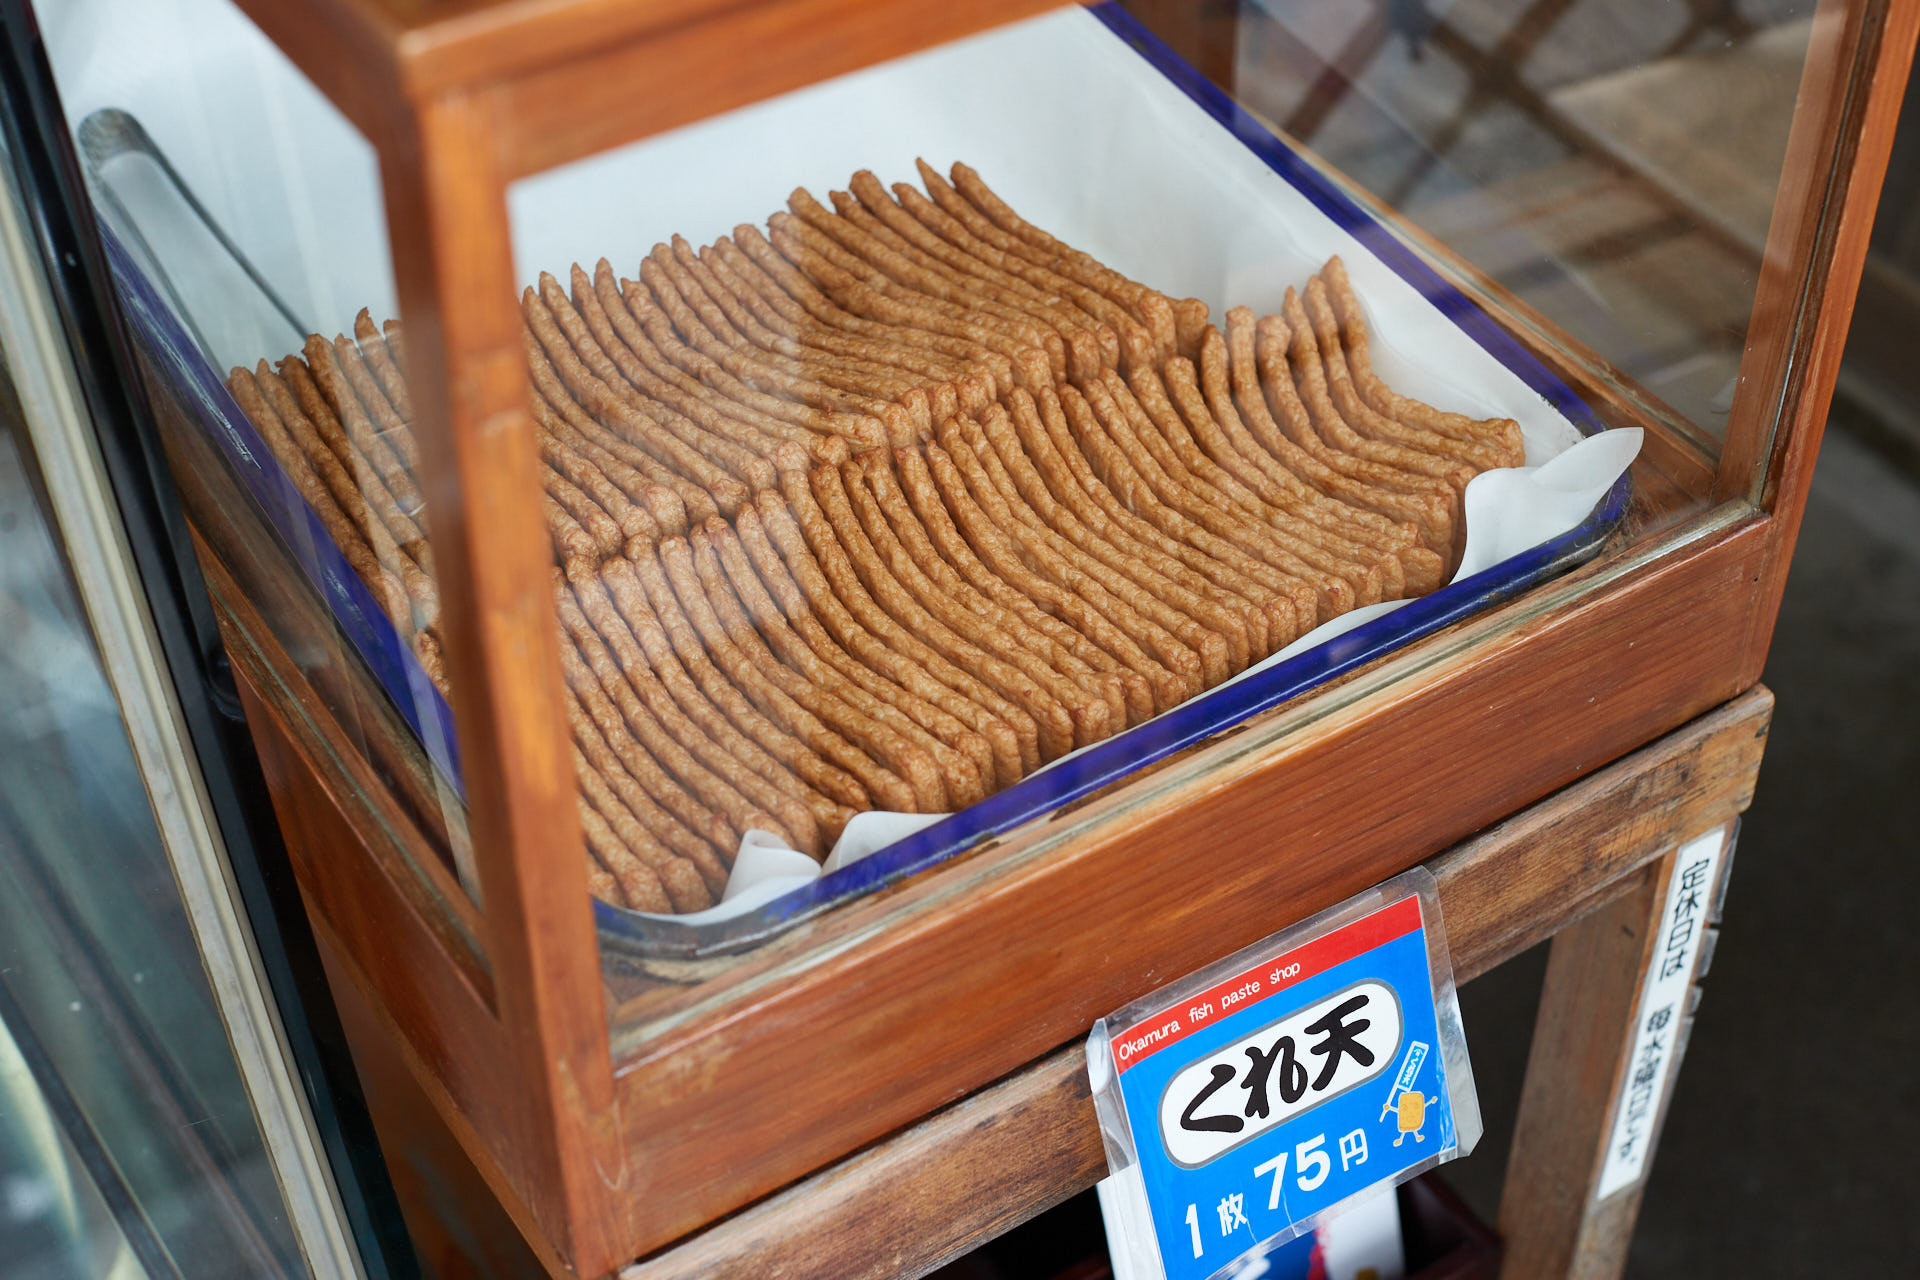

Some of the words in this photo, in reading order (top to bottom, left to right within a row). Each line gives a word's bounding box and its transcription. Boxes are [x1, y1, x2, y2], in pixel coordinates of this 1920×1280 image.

[1659, 858, 1711, 982] 定休日は
[1118, 1020, 1181, 1060] Okamura
[1188, 1002, 1214, 1024] fish
[1221, 981, 1261, 1010] paste
[1269, 962, 1301, 985] shop
[1180, 995, 1375, 1133] くれ天
